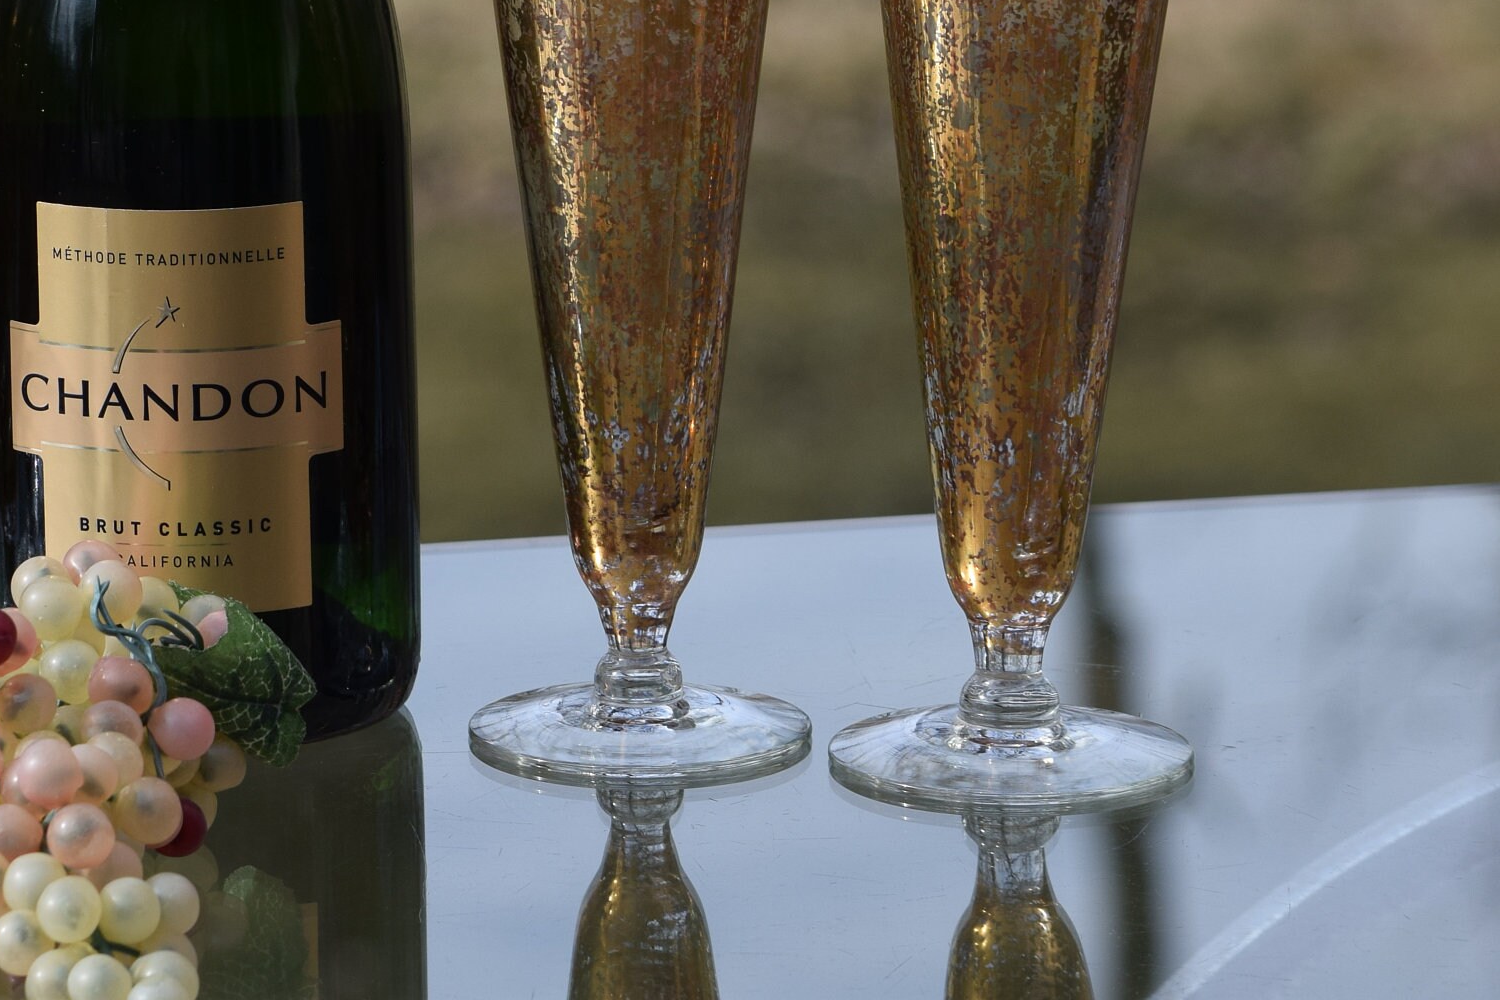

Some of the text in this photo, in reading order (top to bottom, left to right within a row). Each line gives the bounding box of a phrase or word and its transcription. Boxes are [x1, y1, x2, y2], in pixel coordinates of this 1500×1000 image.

[52, 246, 285, 266] MÉTHODE TRADITIONNELLE
[21, 371, 327, 422] CHANDON
[79, 517, 272, 537] BRUT CLASSIC
[118, 554, 234, 568] ALIFORNIA
